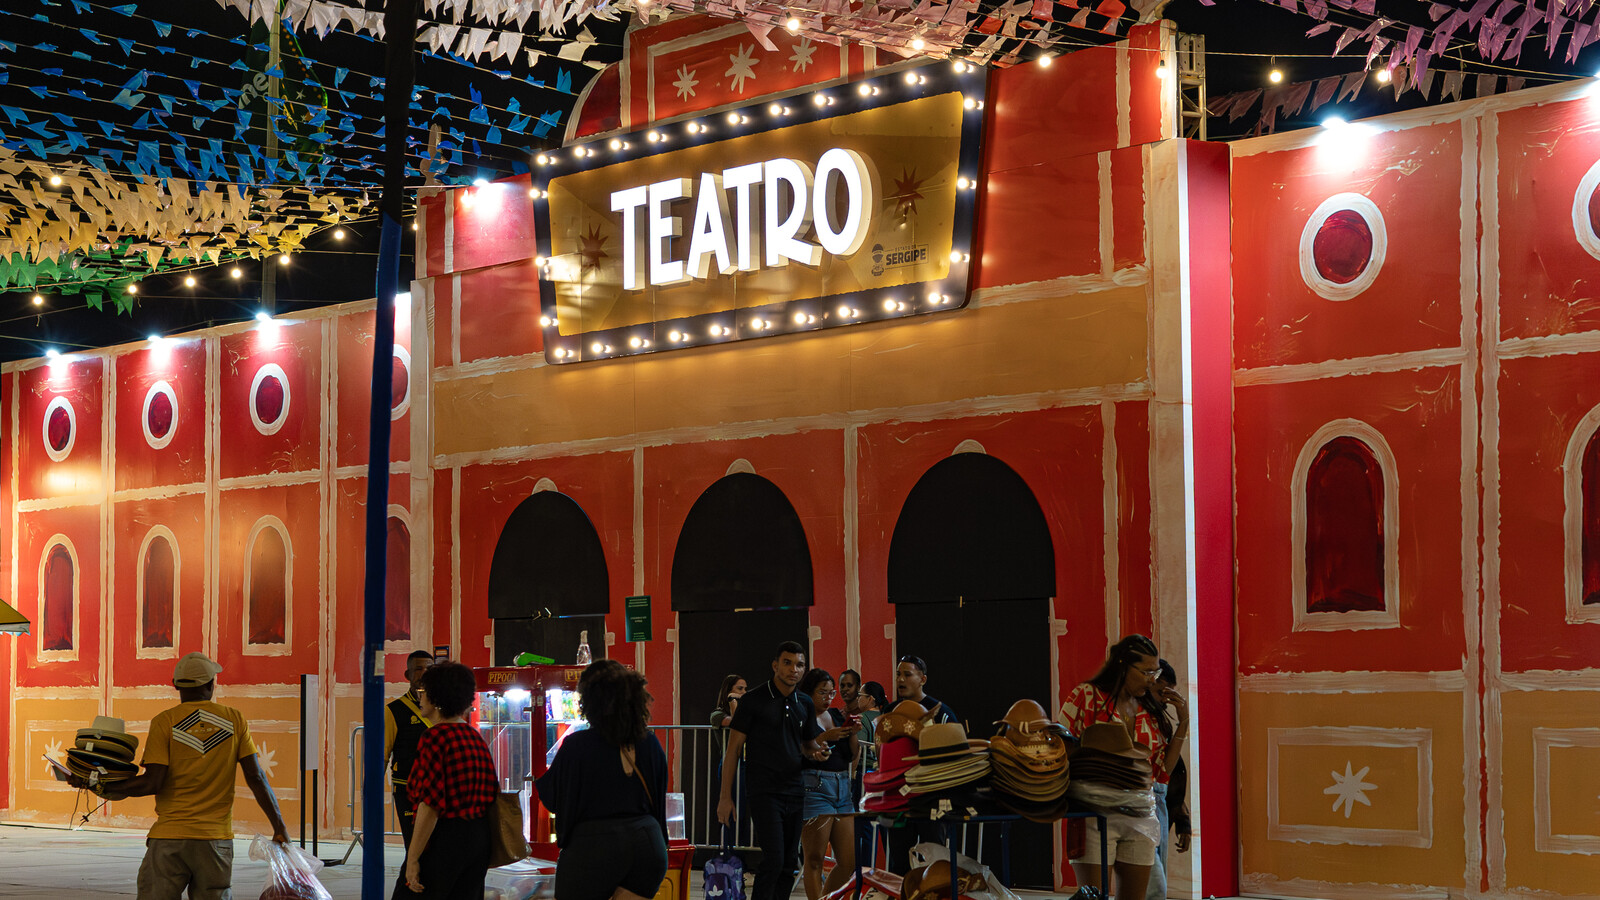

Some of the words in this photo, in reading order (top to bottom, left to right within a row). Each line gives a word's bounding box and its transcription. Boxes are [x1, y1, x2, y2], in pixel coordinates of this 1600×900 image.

[610, 148, 872, 291] TEATRO
[886, 248, 926, 266] SERGIPE
[488, 672, 517, 684] PIPOCA
